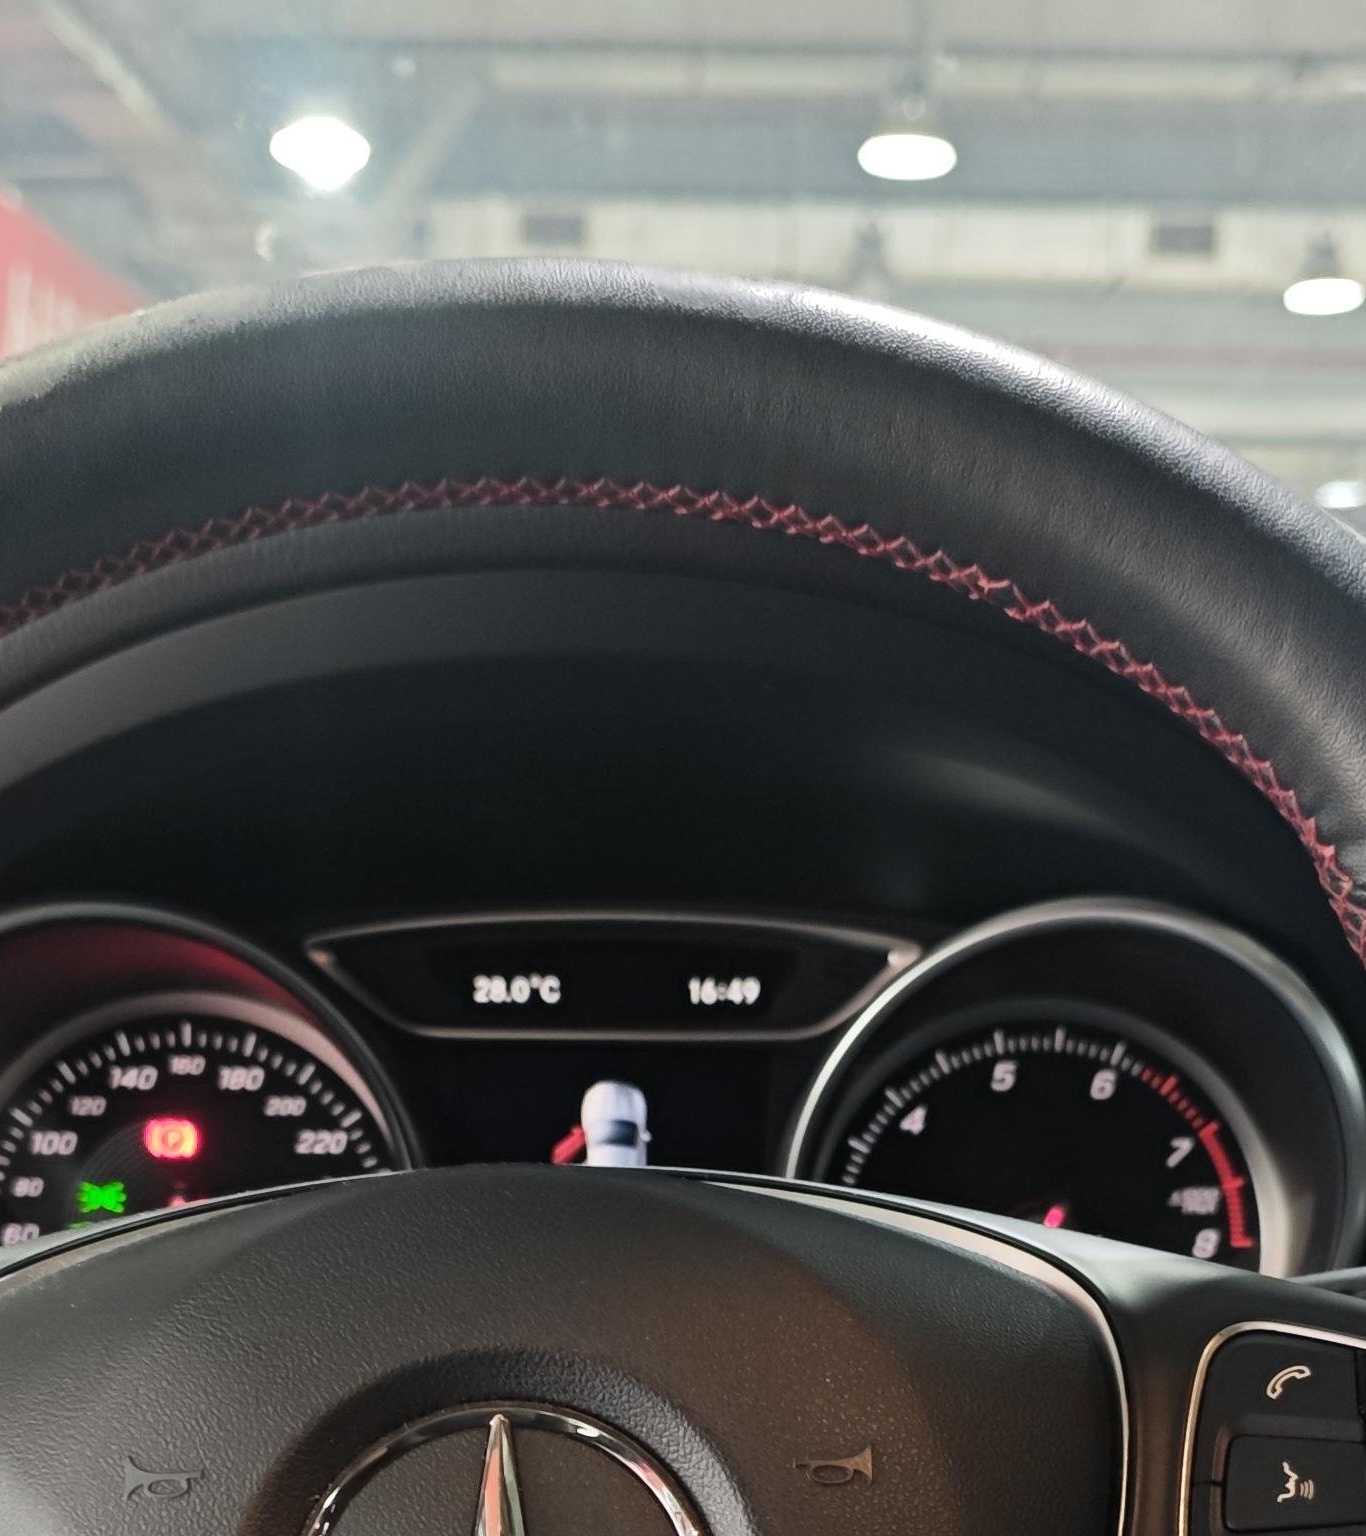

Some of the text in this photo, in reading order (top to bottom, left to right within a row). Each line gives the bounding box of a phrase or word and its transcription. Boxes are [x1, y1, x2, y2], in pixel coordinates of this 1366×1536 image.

[688, 978, 761, 1004] 16:49
[109, 1066, 159, 1091] 140
[990, 1061, 1017, 1092] 5
[1090, 1069, 1116, 1100] 6
[264, 1095, 307, 1117] 200
[899, 1104, 928, 1136] 4
[30, 1130, 78, 1156] 100
[295, 1130, 348, 1155] 220
[1166, 1137, 1194, 1168] 7
